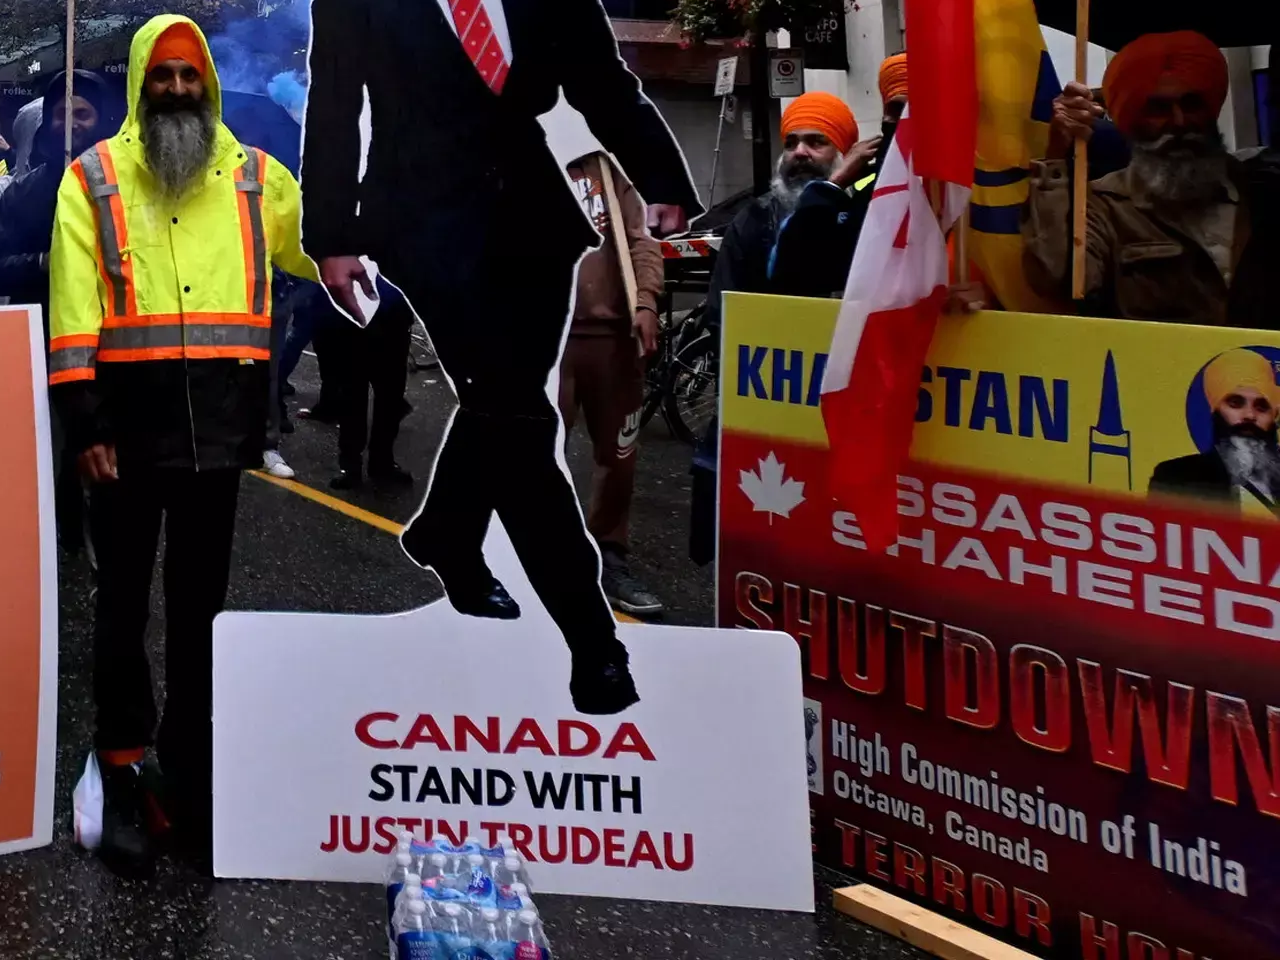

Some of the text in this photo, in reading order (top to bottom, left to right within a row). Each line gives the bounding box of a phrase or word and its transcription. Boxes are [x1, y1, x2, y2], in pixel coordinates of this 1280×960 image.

[354, 712, 657, 761] CANADA
[734, 571, 1280, 818] SHUTDOWN
[368, 764, 642, 814] STAND WITH
[831, 718, 1248, 897] High Commission of India
[833, 769, 935, 837] Ottawa,
[945, 809, 1049, 873] Canada
[480, 822, 694, 872] TRUDEAU
[834, 819, 1053, 947] TERROR
